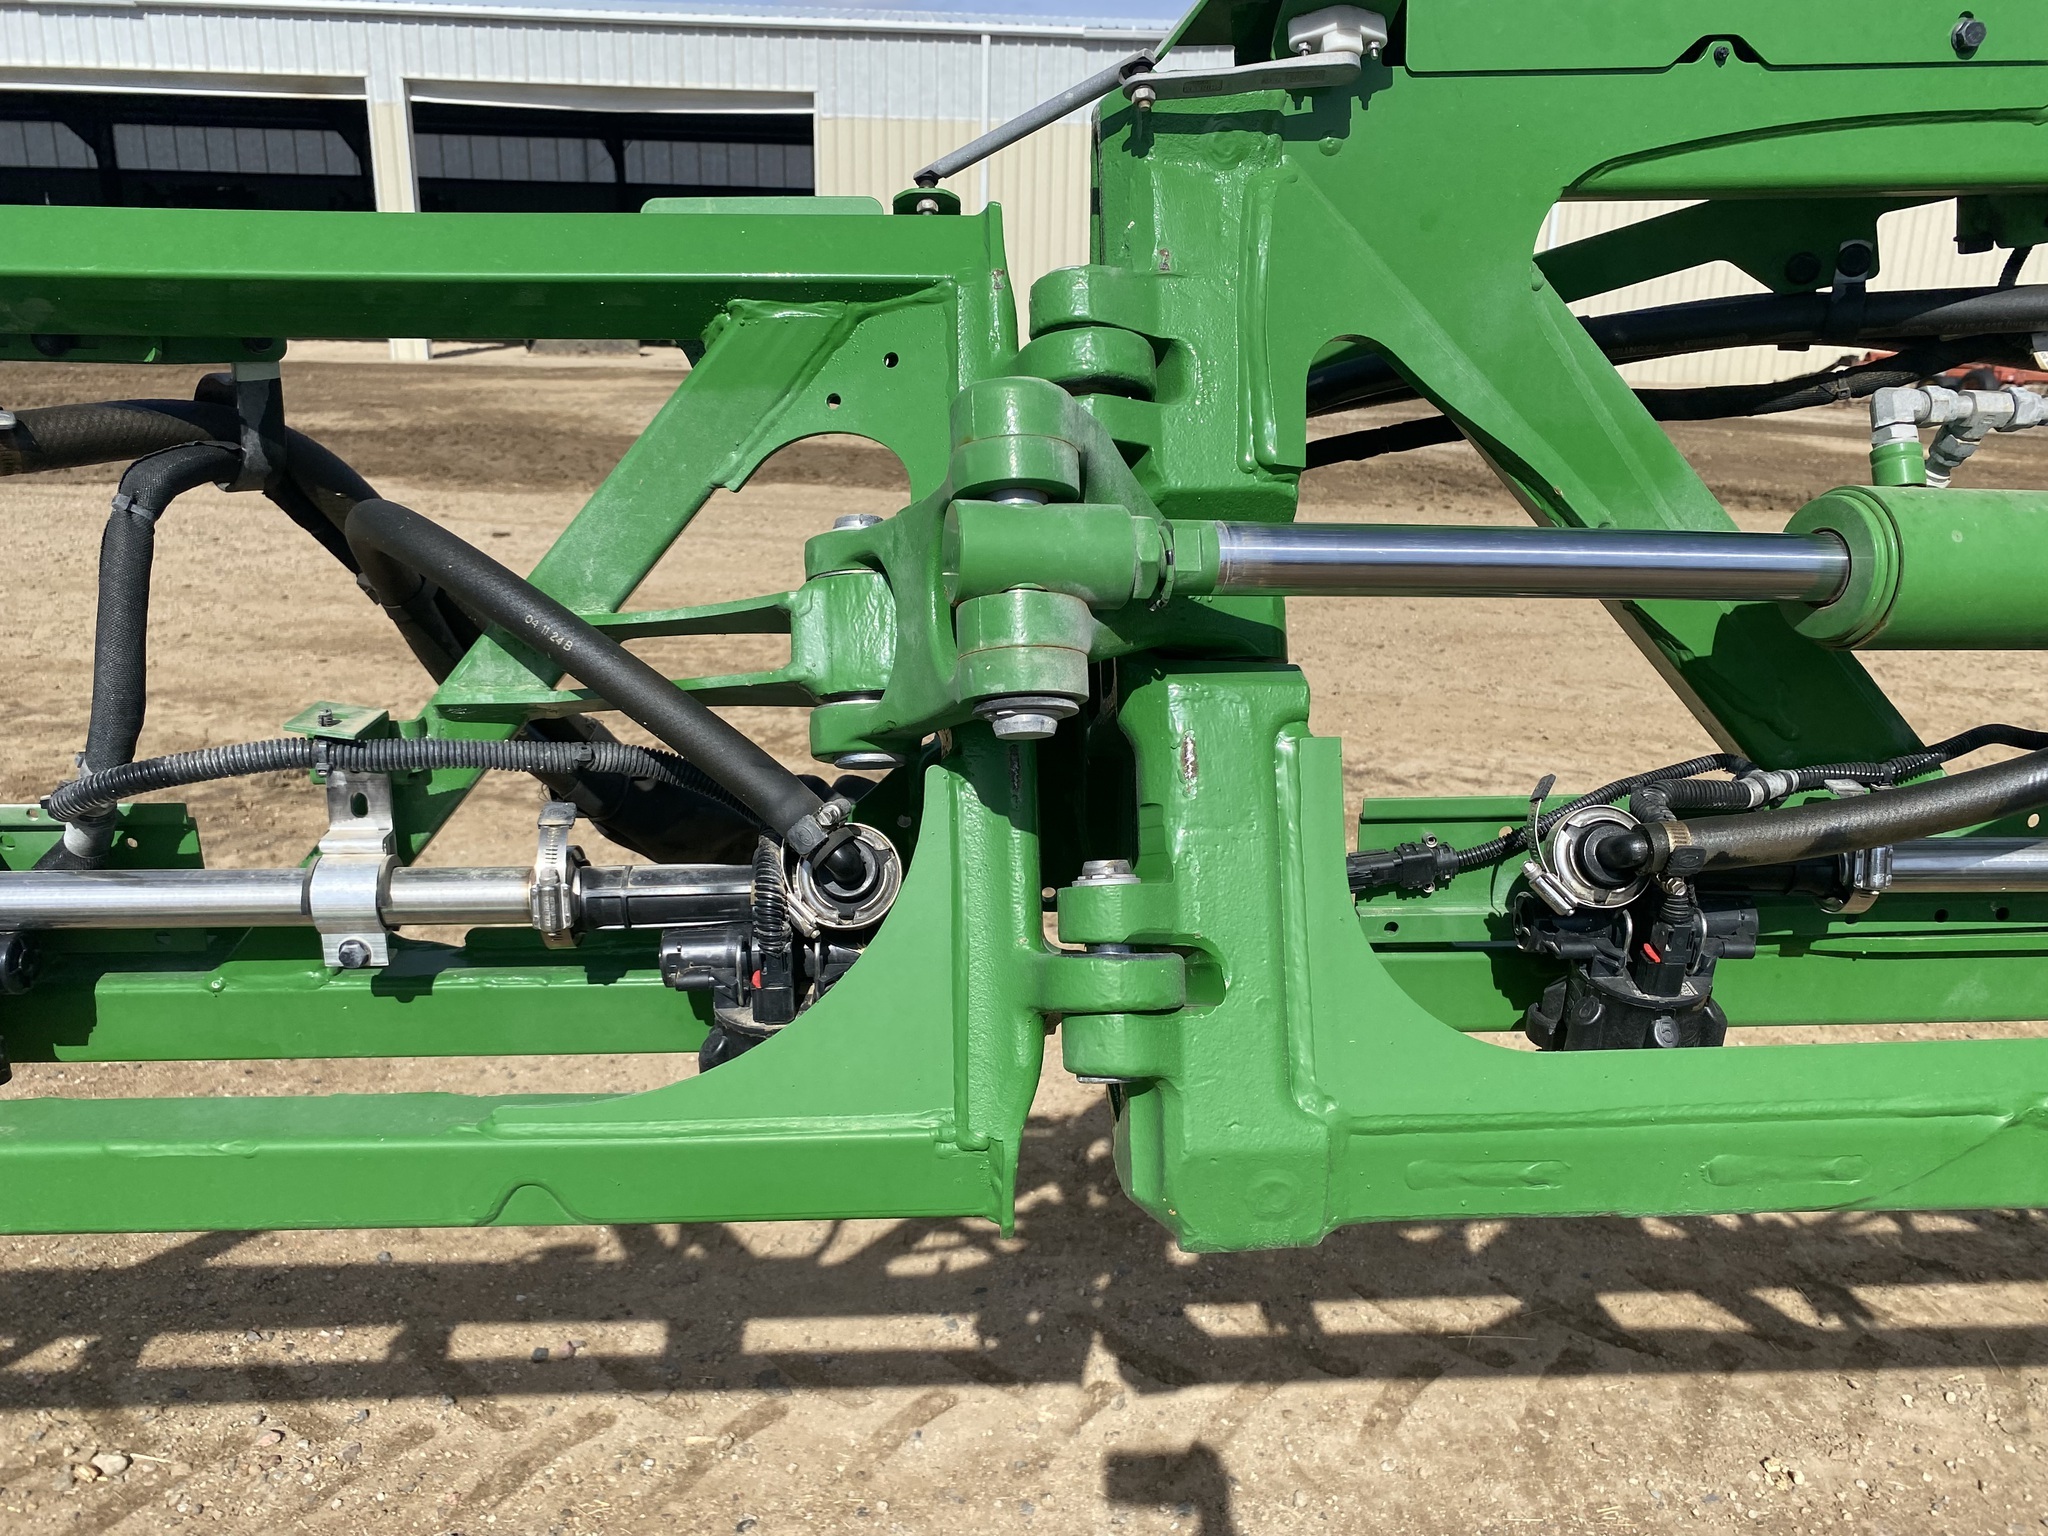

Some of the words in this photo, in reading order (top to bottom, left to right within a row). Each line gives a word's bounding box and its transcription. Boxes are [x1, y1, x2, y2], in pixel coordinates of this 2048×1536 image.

[525, 614, 539, 628] 04
[541, 625, 551, 636] 11
[549, 632, 565, 646] 24
[563, 640, 573, 651] B
[1660, 1021, 1674, 1043] 5
